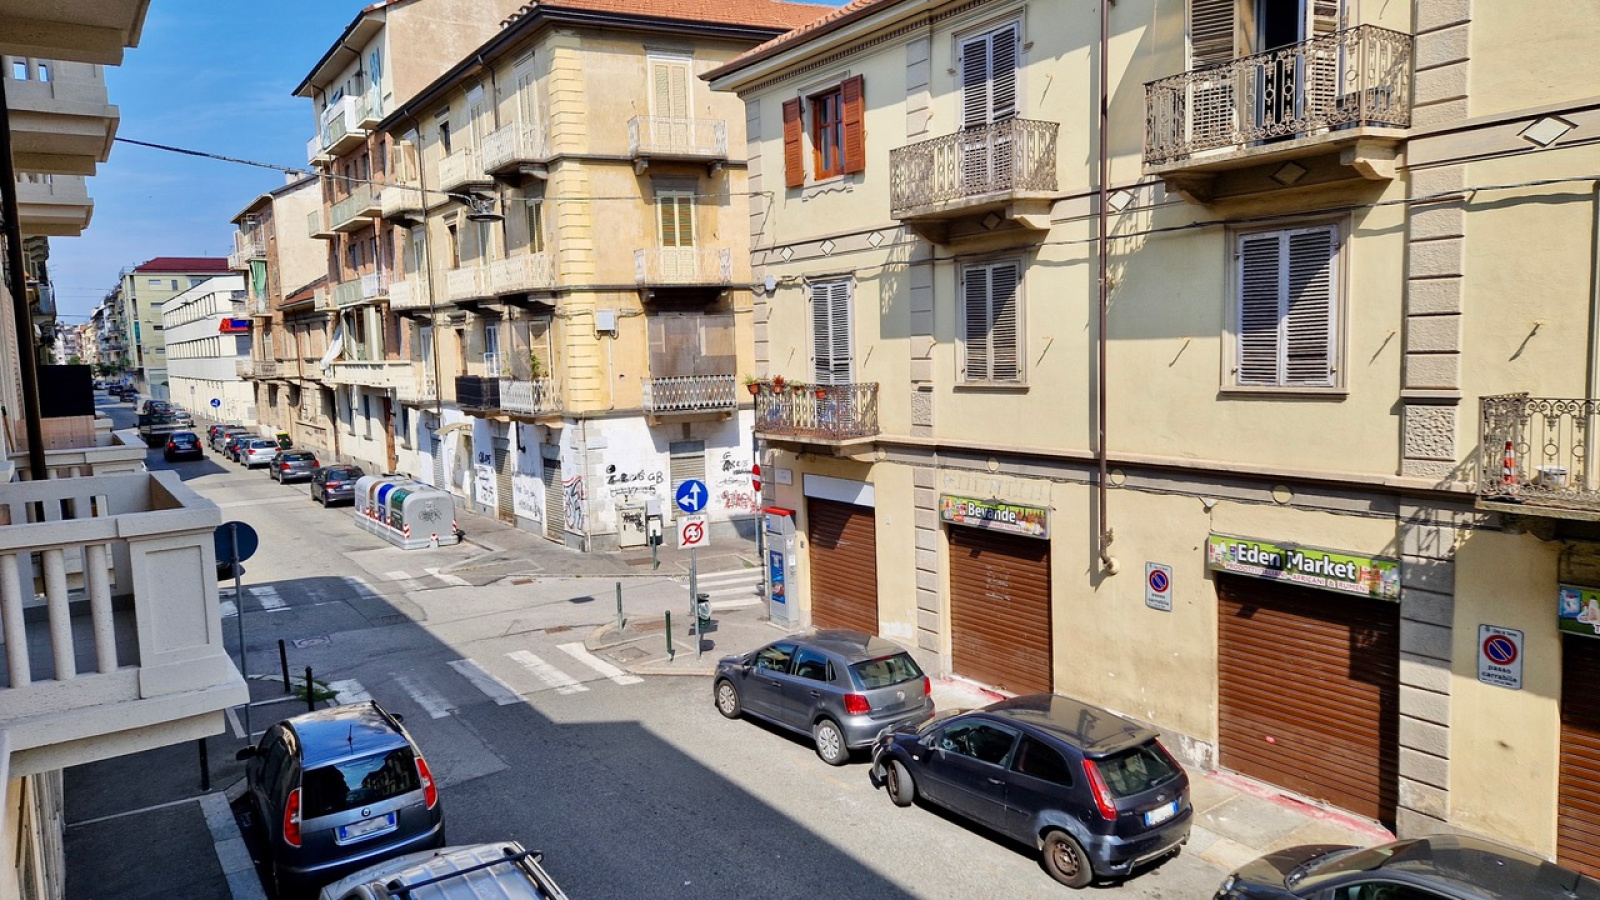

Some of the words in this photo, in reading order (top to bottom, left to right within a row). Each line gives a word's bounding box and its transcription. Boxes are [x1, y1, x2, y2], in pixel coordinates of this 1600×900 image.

[968, 502, 1016, 522] Bevande
[1238, 543, 1280, 566] Eden
[1287, 551, 1356, 580] Market
[1481, 671, 1517, 683] carrabile
[1488, 665, 1512, 674] passo
